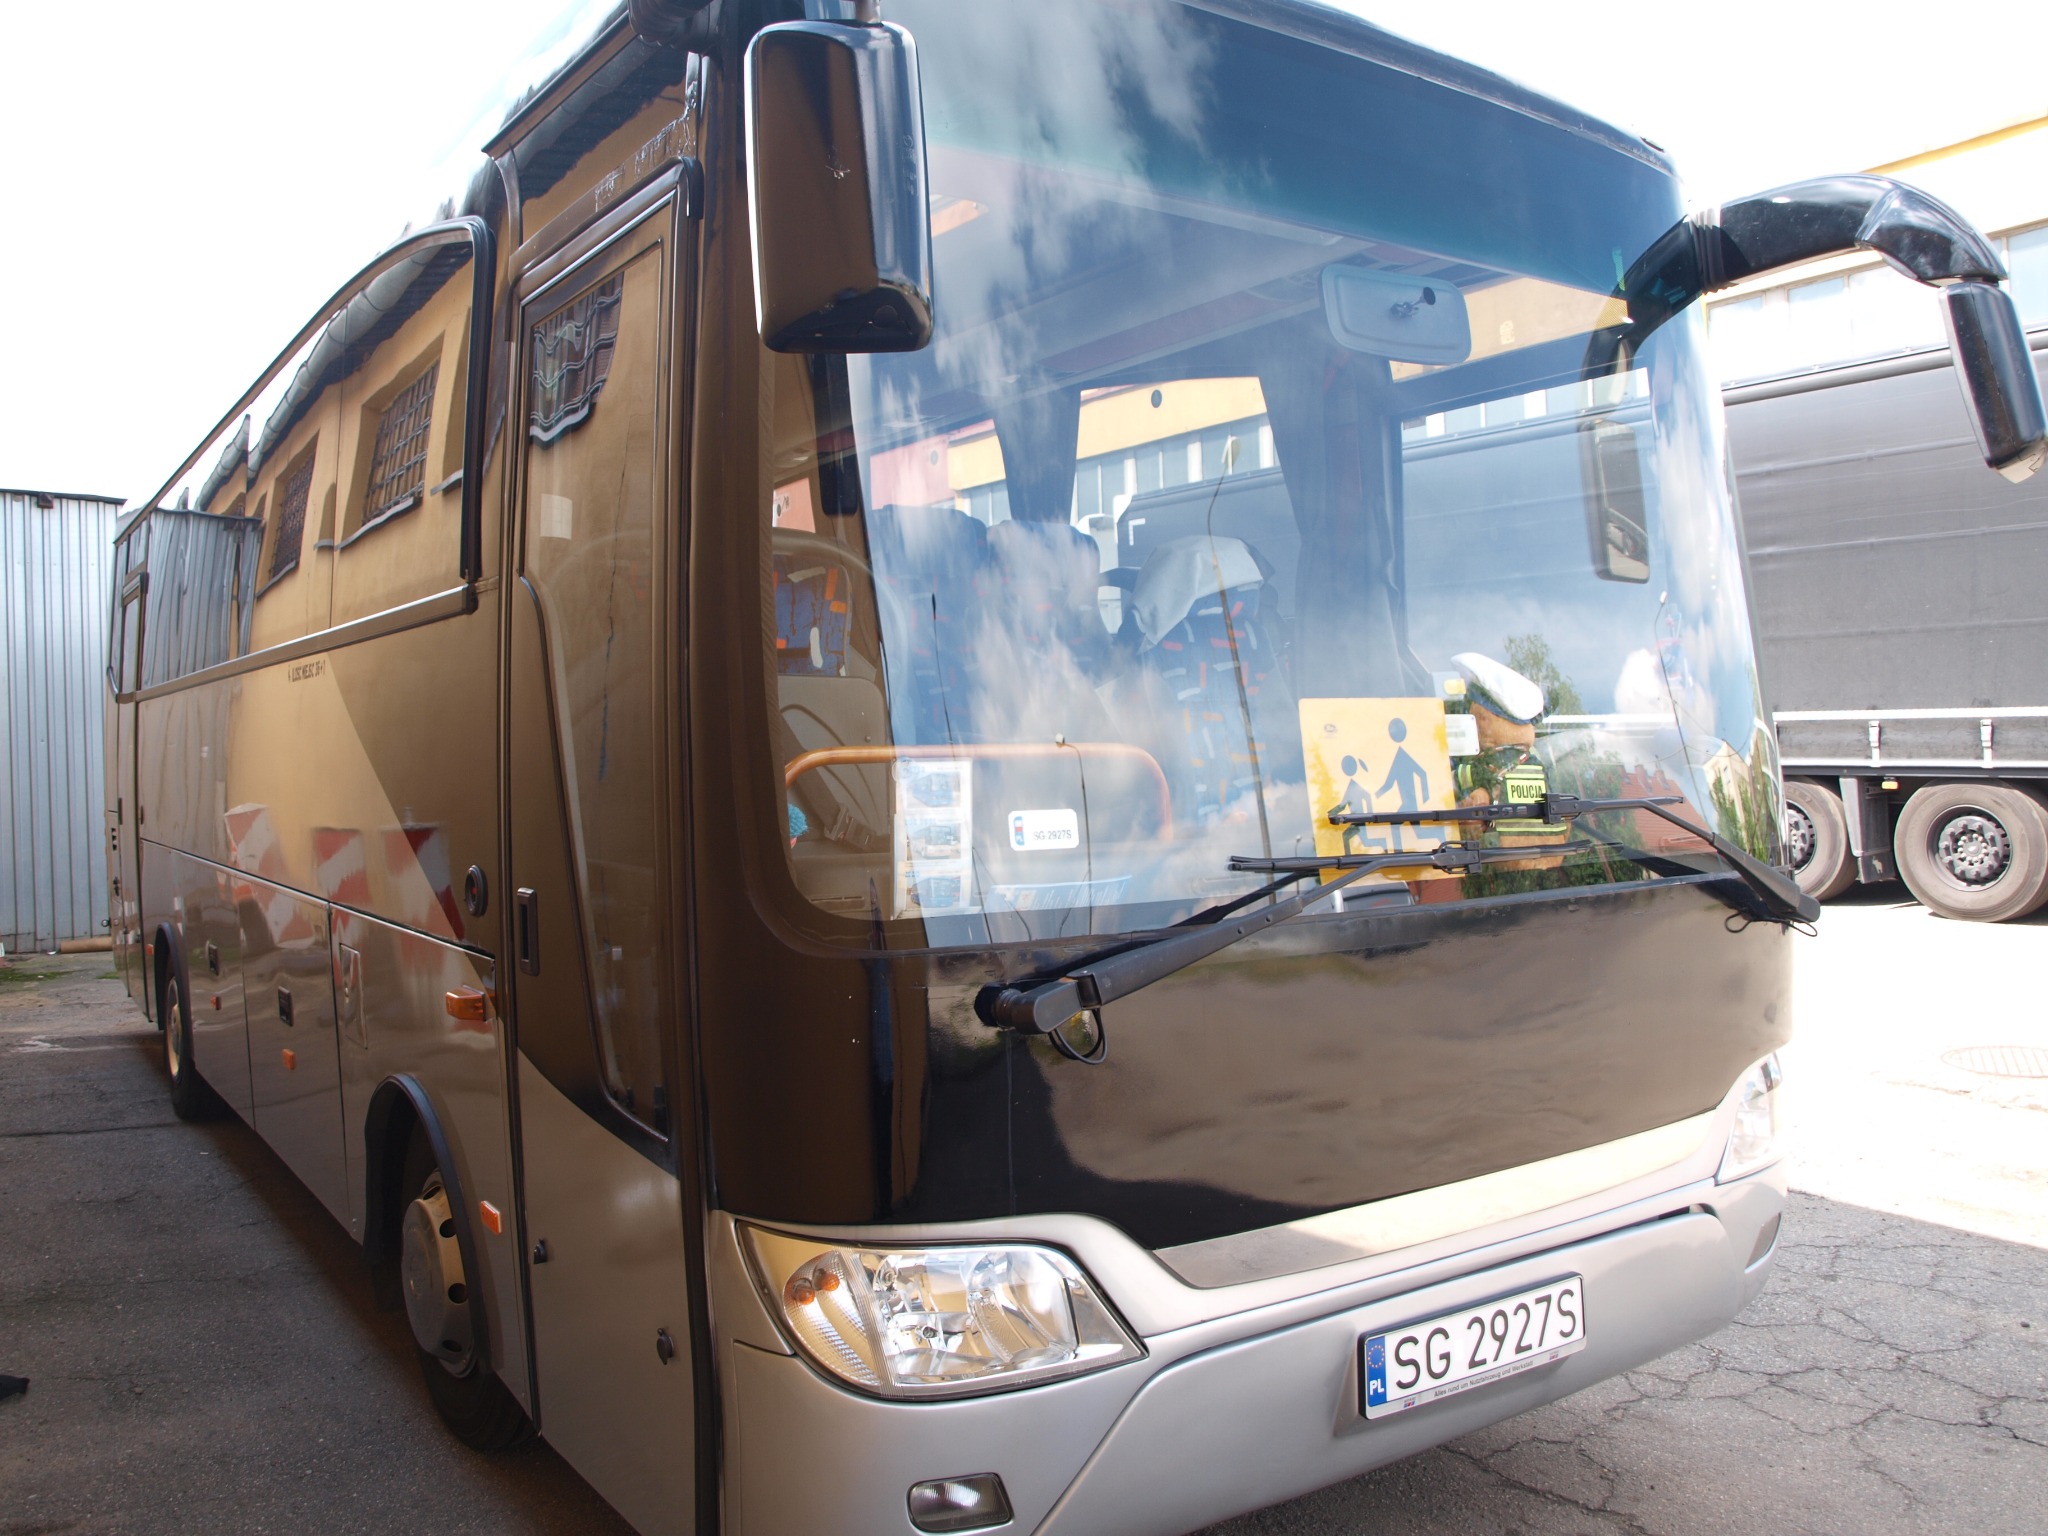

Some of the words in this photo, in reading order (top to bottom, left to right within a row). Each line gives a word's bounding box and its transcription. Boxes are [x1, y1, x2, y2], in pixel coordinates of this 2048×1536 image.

[1033, 830, 1046, 841] SG
[1047, 829, 1072, 840] 2927S
[1394, 1327, 1450, 1390] SG
[1467, 1288, 1577, 1370] 2927S
[1369, 1378, 1385, 1396] PL
[1433, 1388, 1448, 1398] Alles
[1448, 1385, 1460, 1393] rund
[1461, 1382, 1469, 1390] um
[1469, 1371, 1502, 1387] Nutzfahrzeug
[1501, 1367, 1512, 1377] und
[1512, 1360, 1534, 1373] Werkstatt
